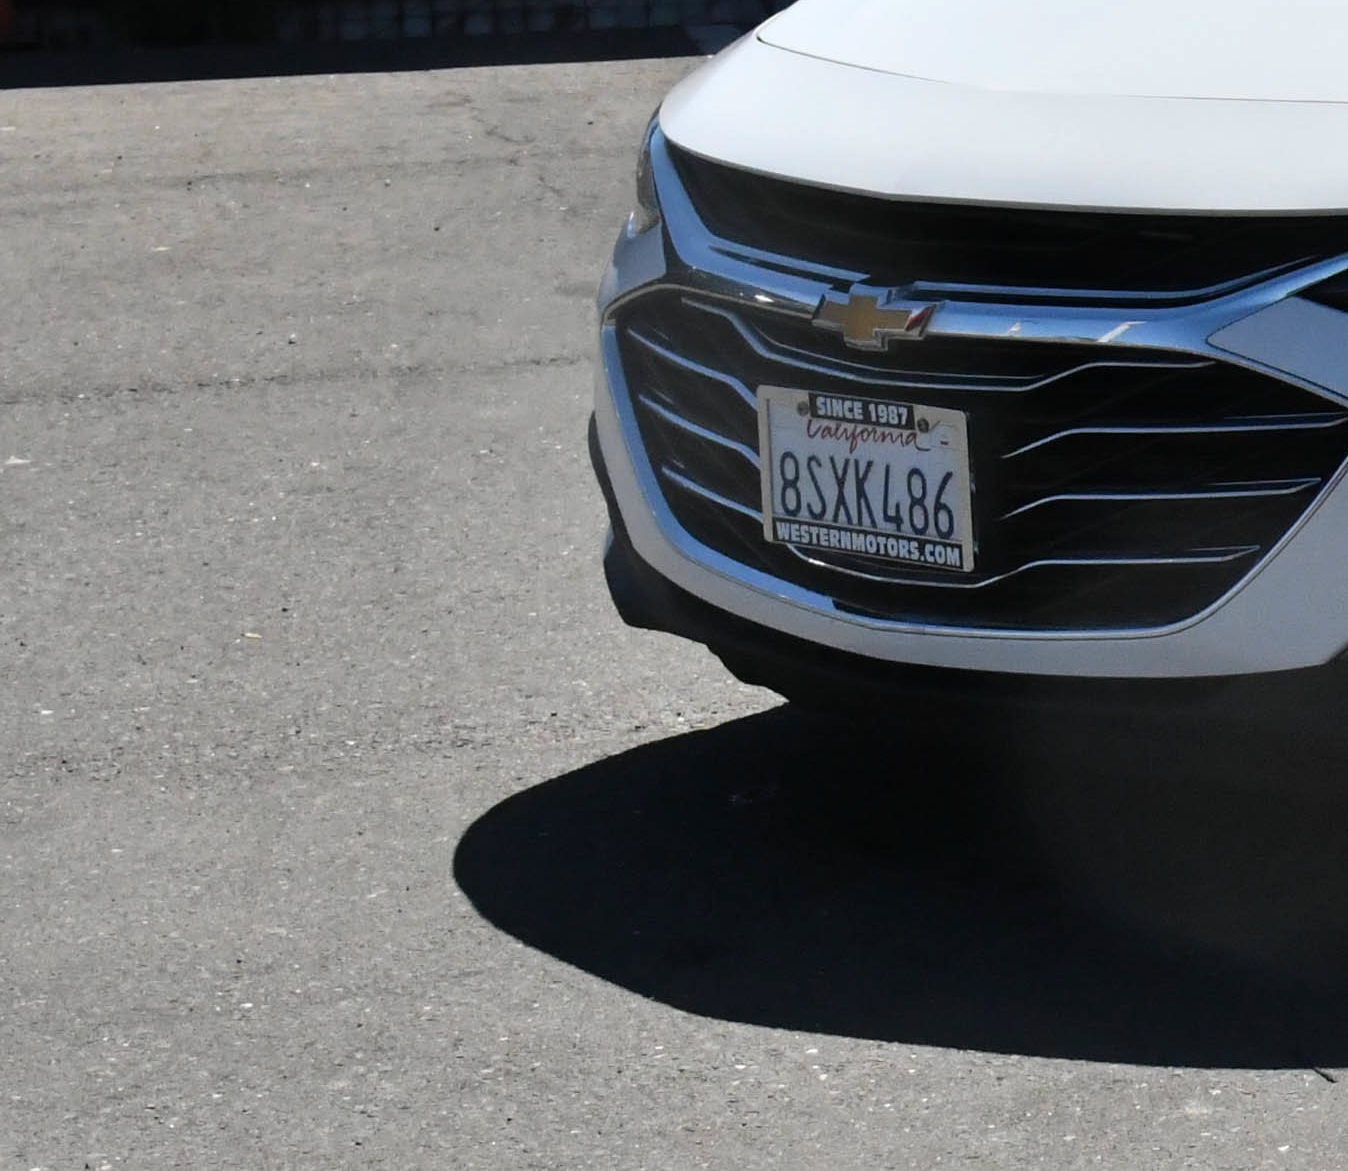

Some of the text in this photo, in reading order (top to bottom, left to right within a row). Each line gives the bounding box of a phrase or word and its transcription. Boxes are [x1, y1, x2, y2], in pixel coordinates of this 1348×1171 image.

[816, 396, 908, 425] SINCE 1987
[806, 419, 930, 454] California
[780, 451, 955, 539] 8SXK486
[776, 521, 961, 567] WESTERNMOTORS.COM
